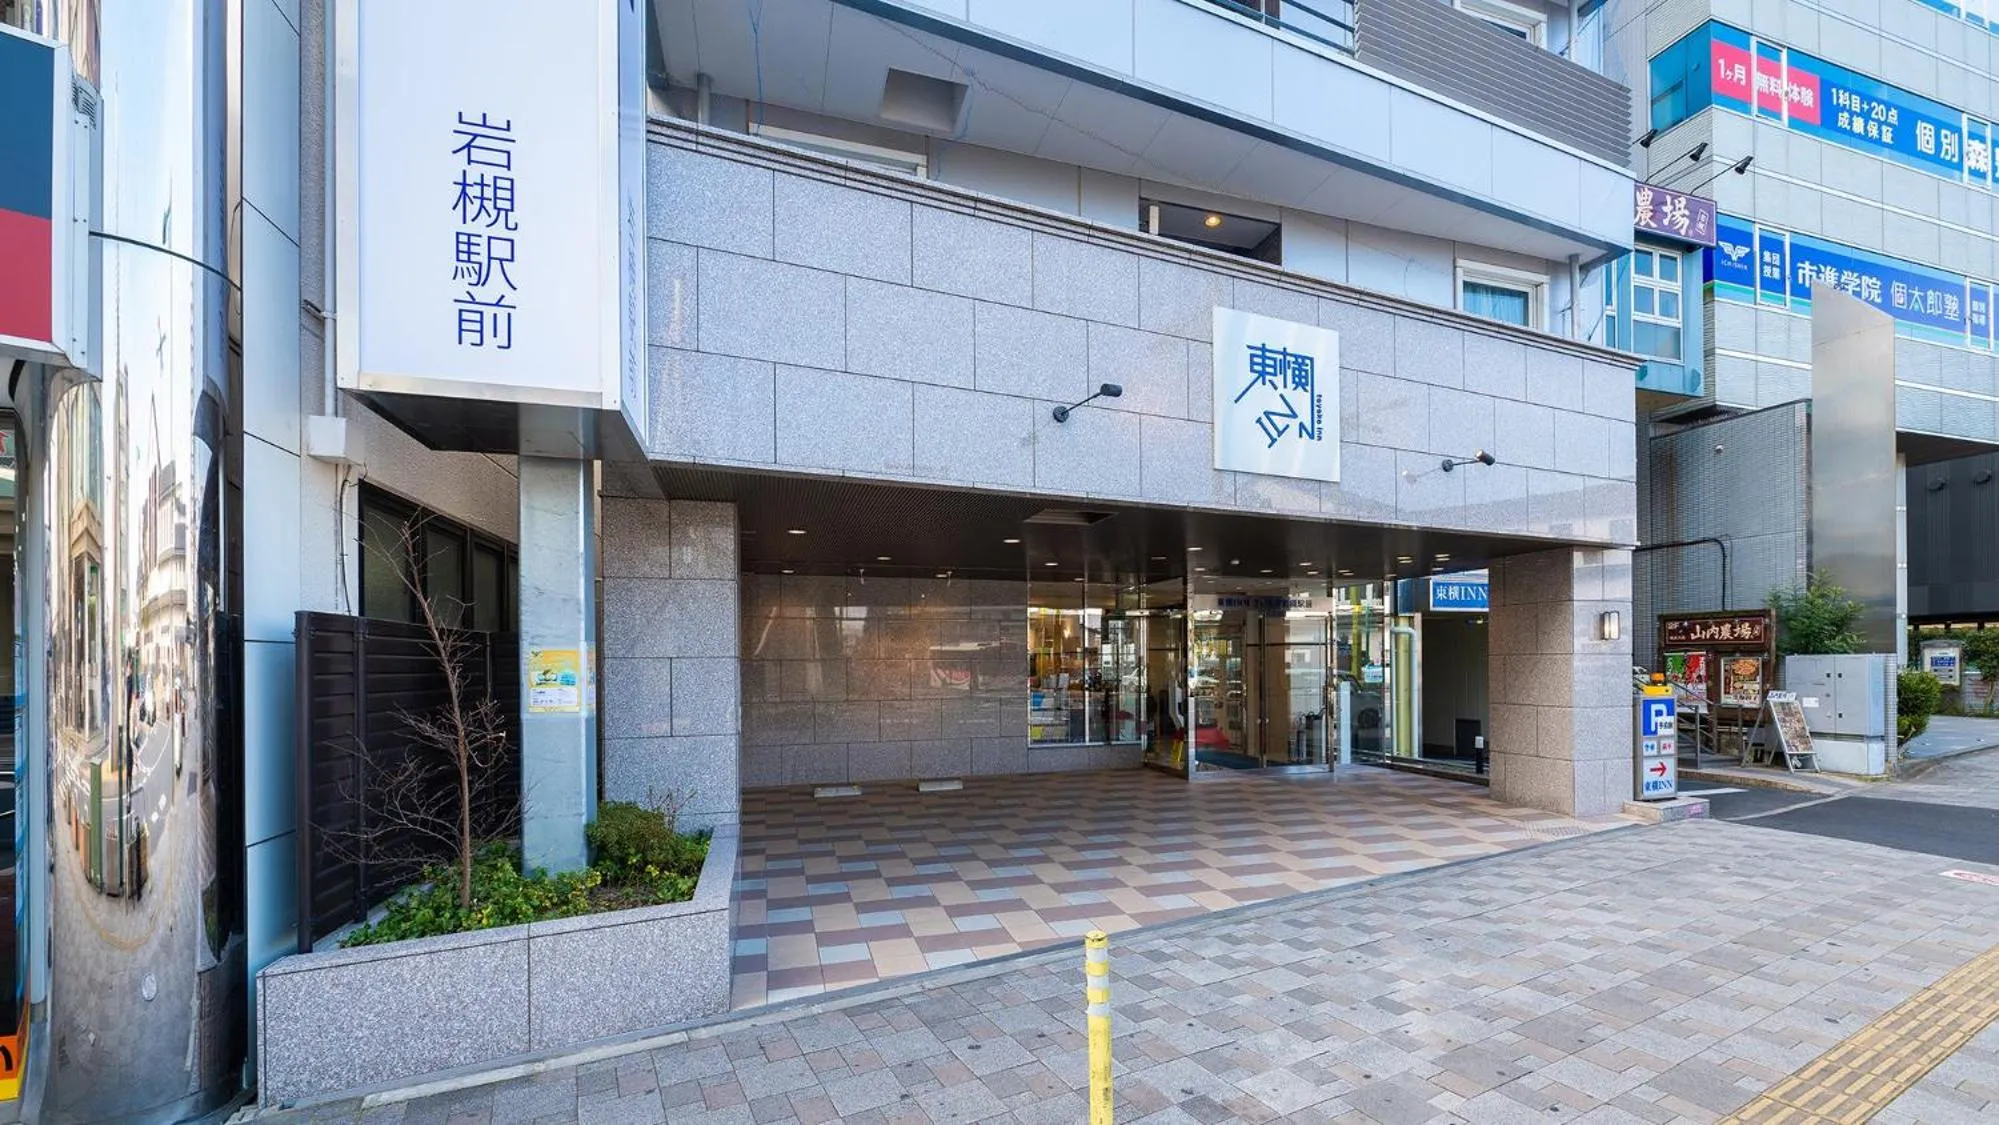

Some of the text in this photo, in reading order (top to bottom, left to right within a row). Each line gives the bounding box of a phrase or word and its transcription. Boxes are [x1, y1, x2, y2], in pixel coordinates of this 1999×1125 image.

[451, 111, 518, 350] 岩槻駅前
[1633, 187, 1691, 236] 農場
[1890, 279, 1961, 321] 個太郎塾
